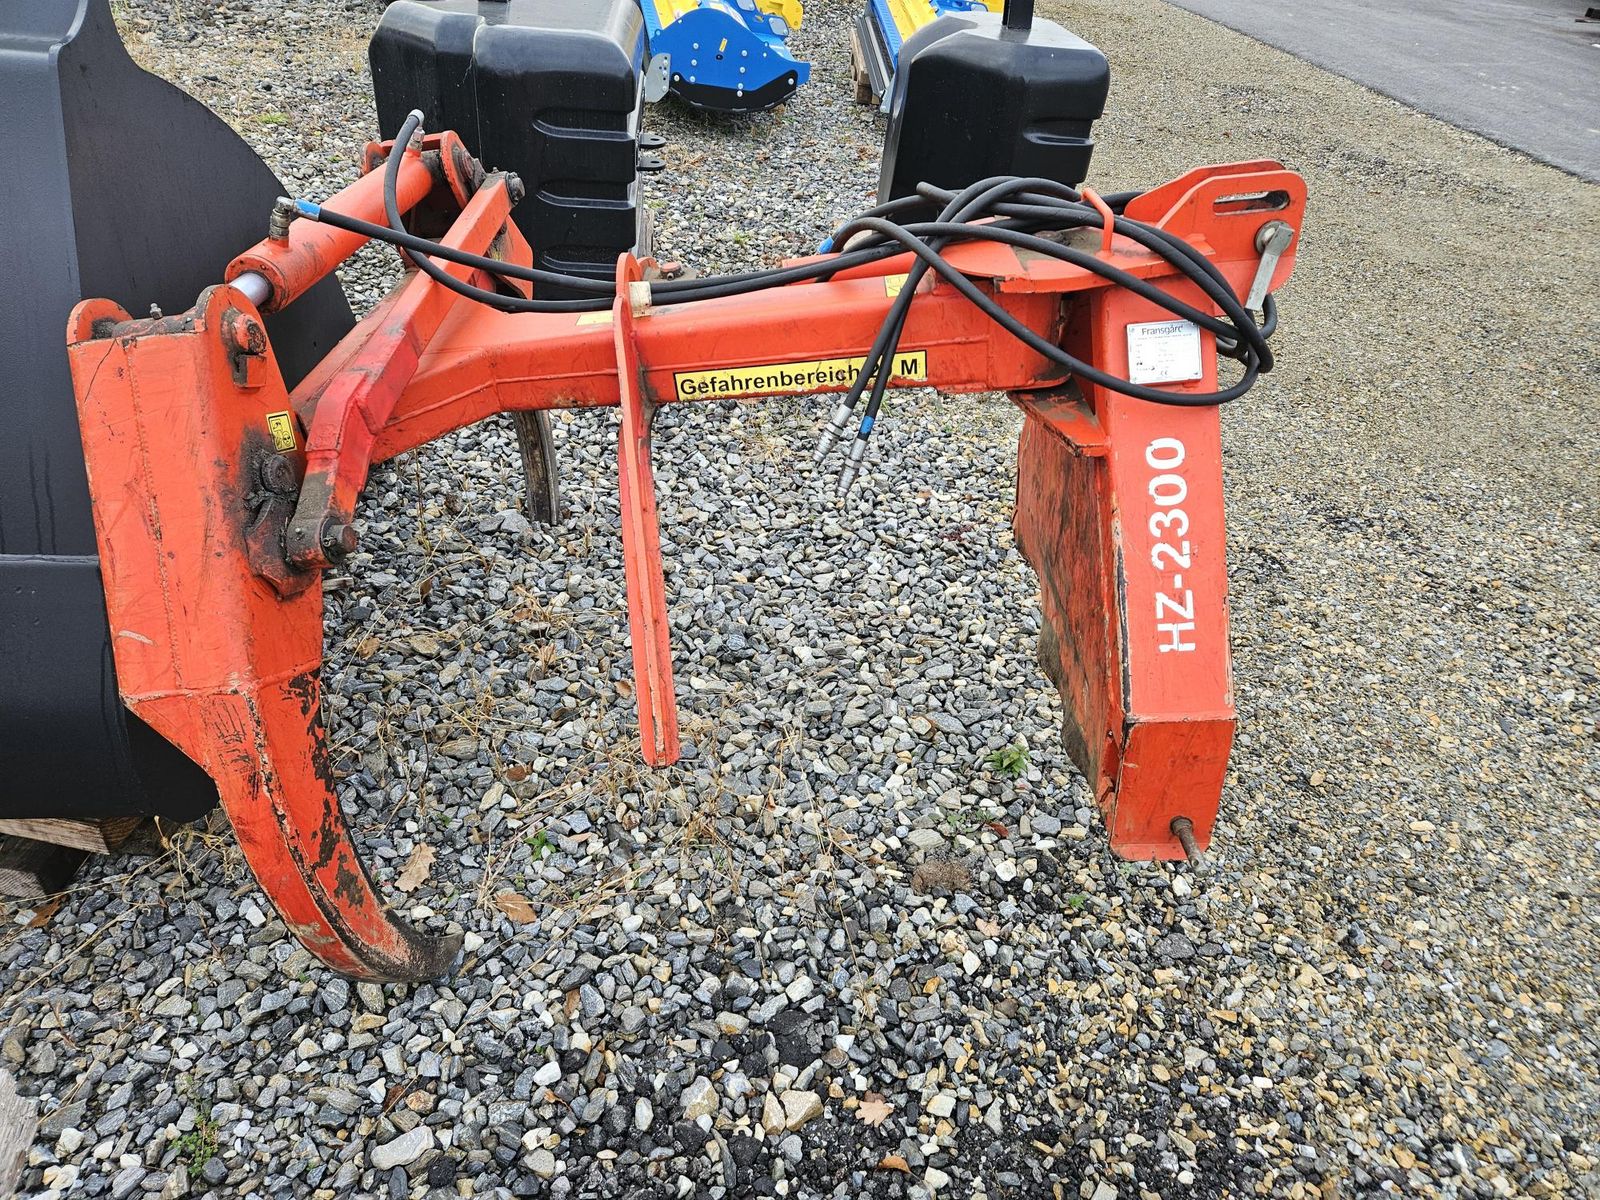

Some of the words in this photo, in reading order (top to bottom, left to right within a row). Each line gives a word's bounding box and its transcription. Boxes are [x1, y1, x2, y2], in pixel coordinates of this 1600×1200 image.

[679, 364, 860, 395] Gefahrenbereich
[900, 358, 918, 376] M
[1145, 437, 1196, 652] HZ-2300
